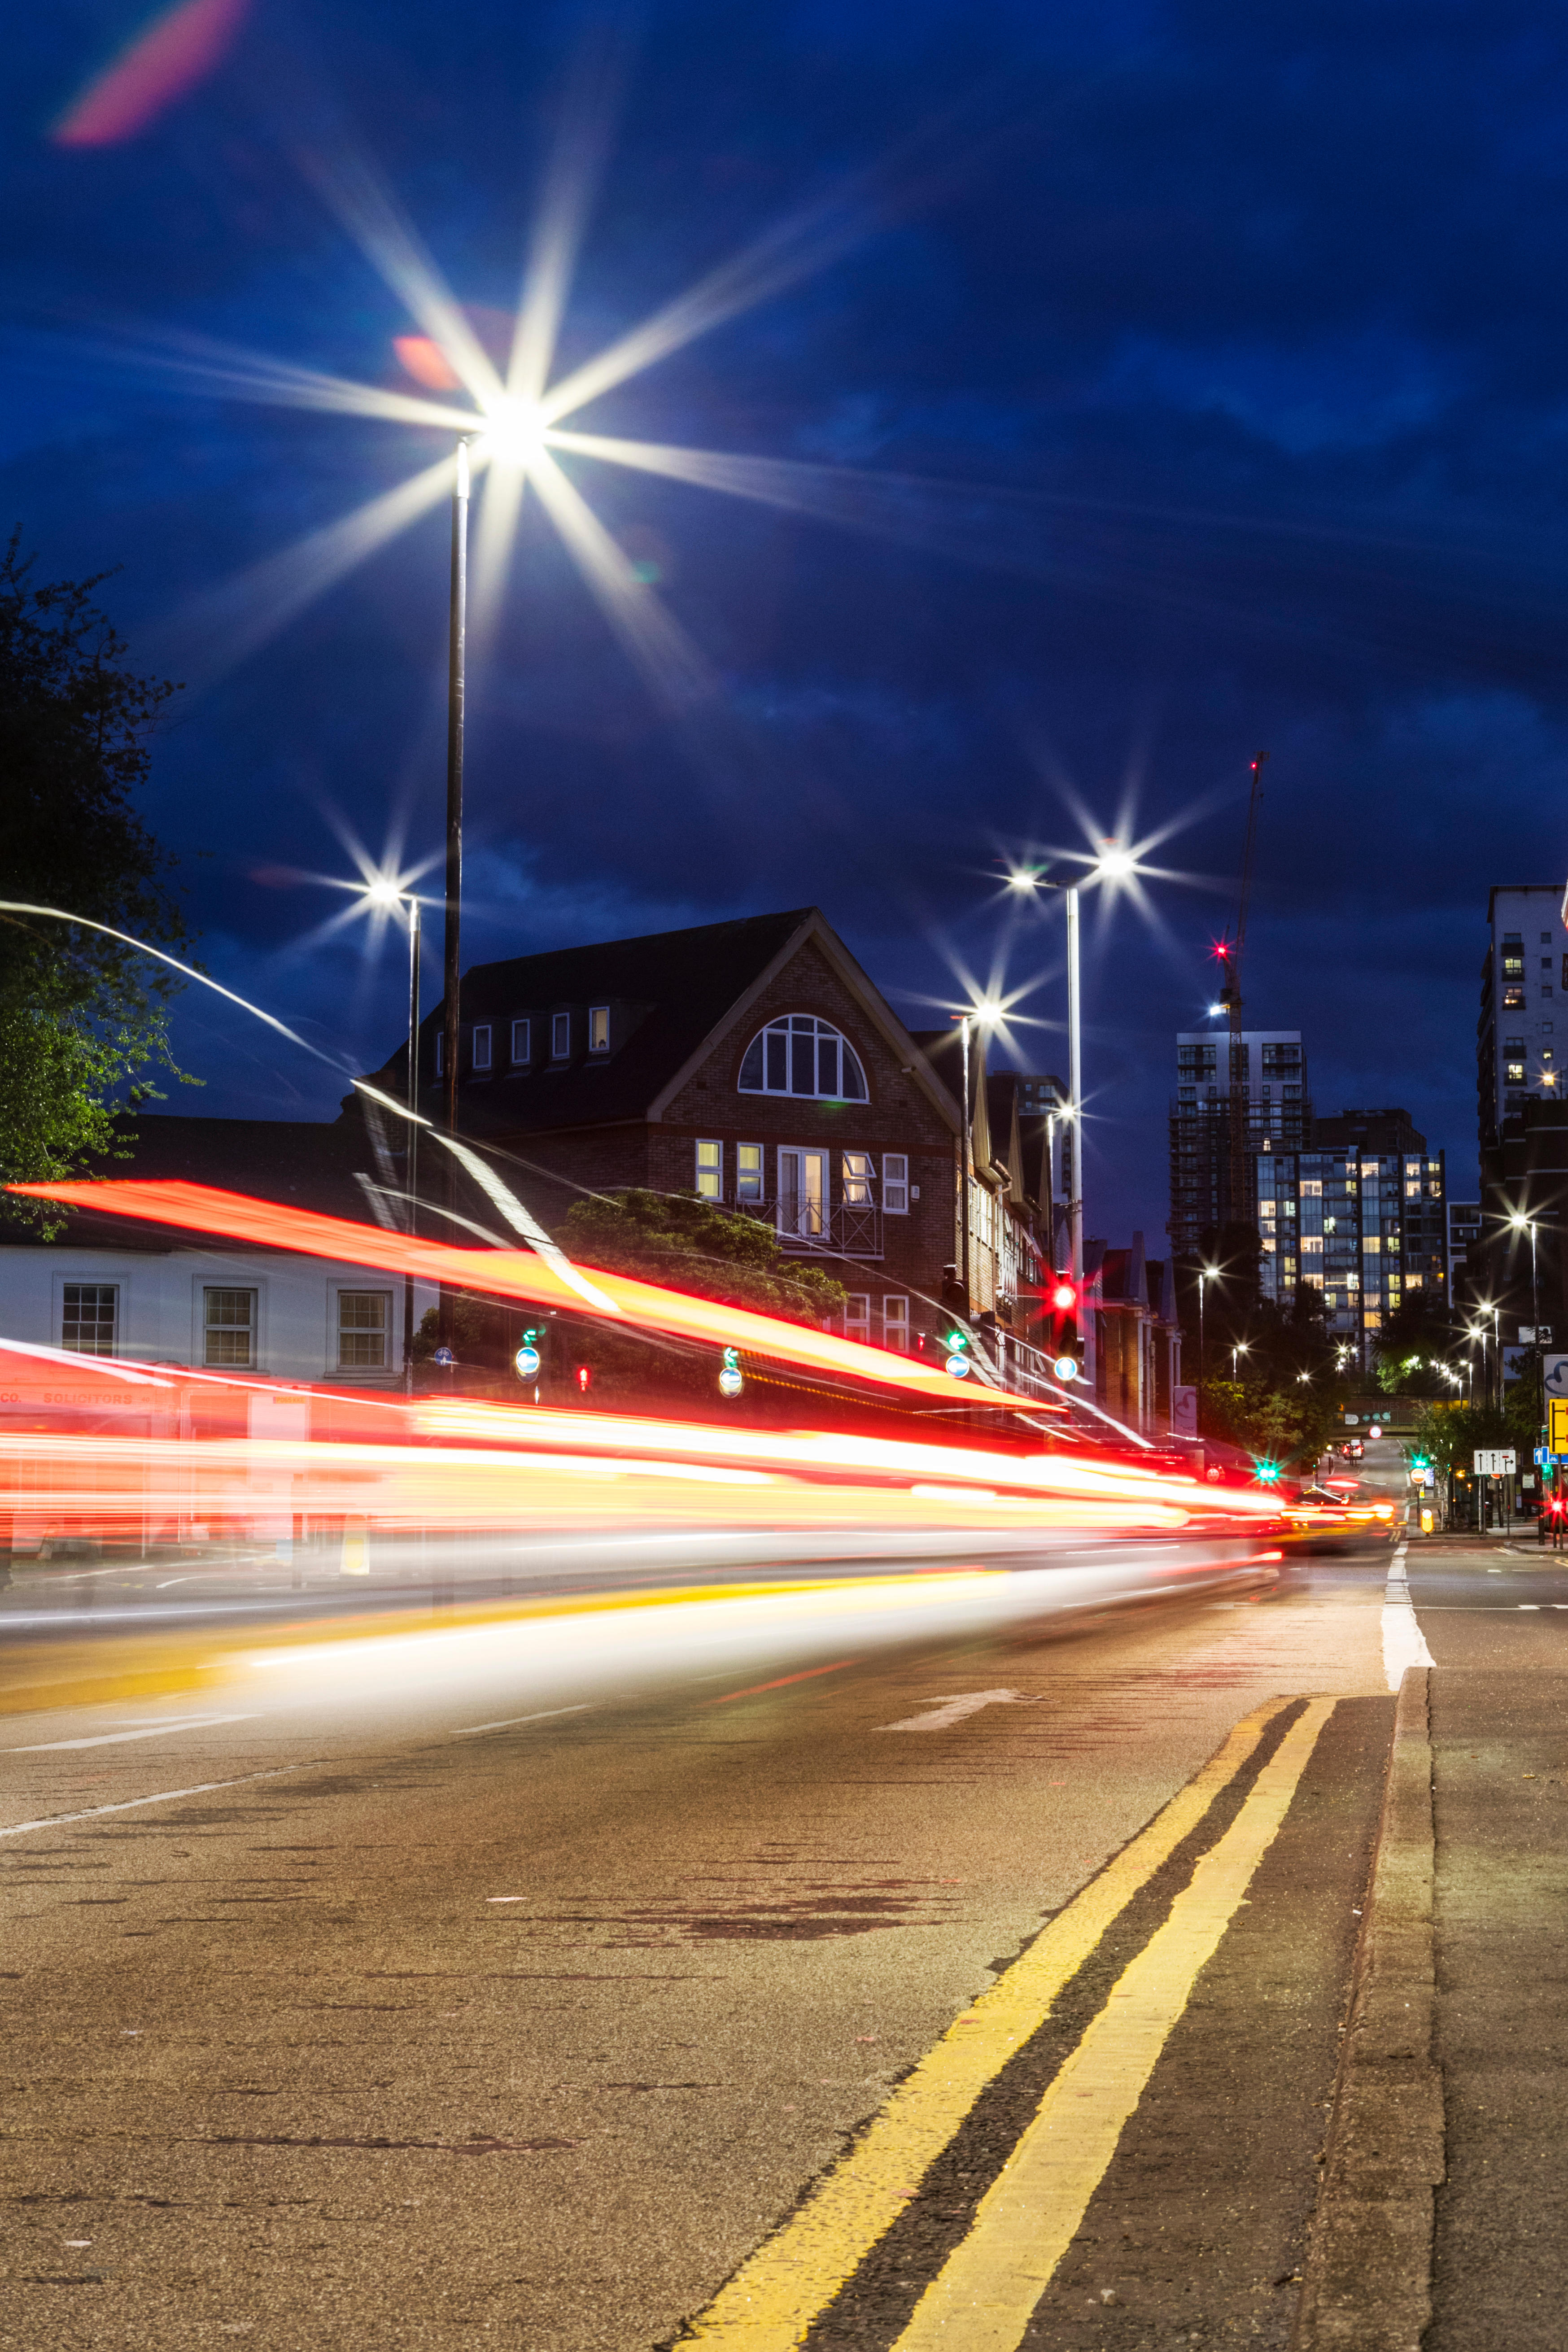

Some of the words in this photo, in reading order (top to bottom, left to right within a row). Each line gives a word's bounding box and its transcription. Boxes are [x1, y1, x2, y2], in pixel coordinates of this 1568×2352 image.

[0, 1393, 22, 1403] CO.
[44, 1393, 132, 1404] SOLICITORS
[1371, 1401, 1400, 1409] TIMES
